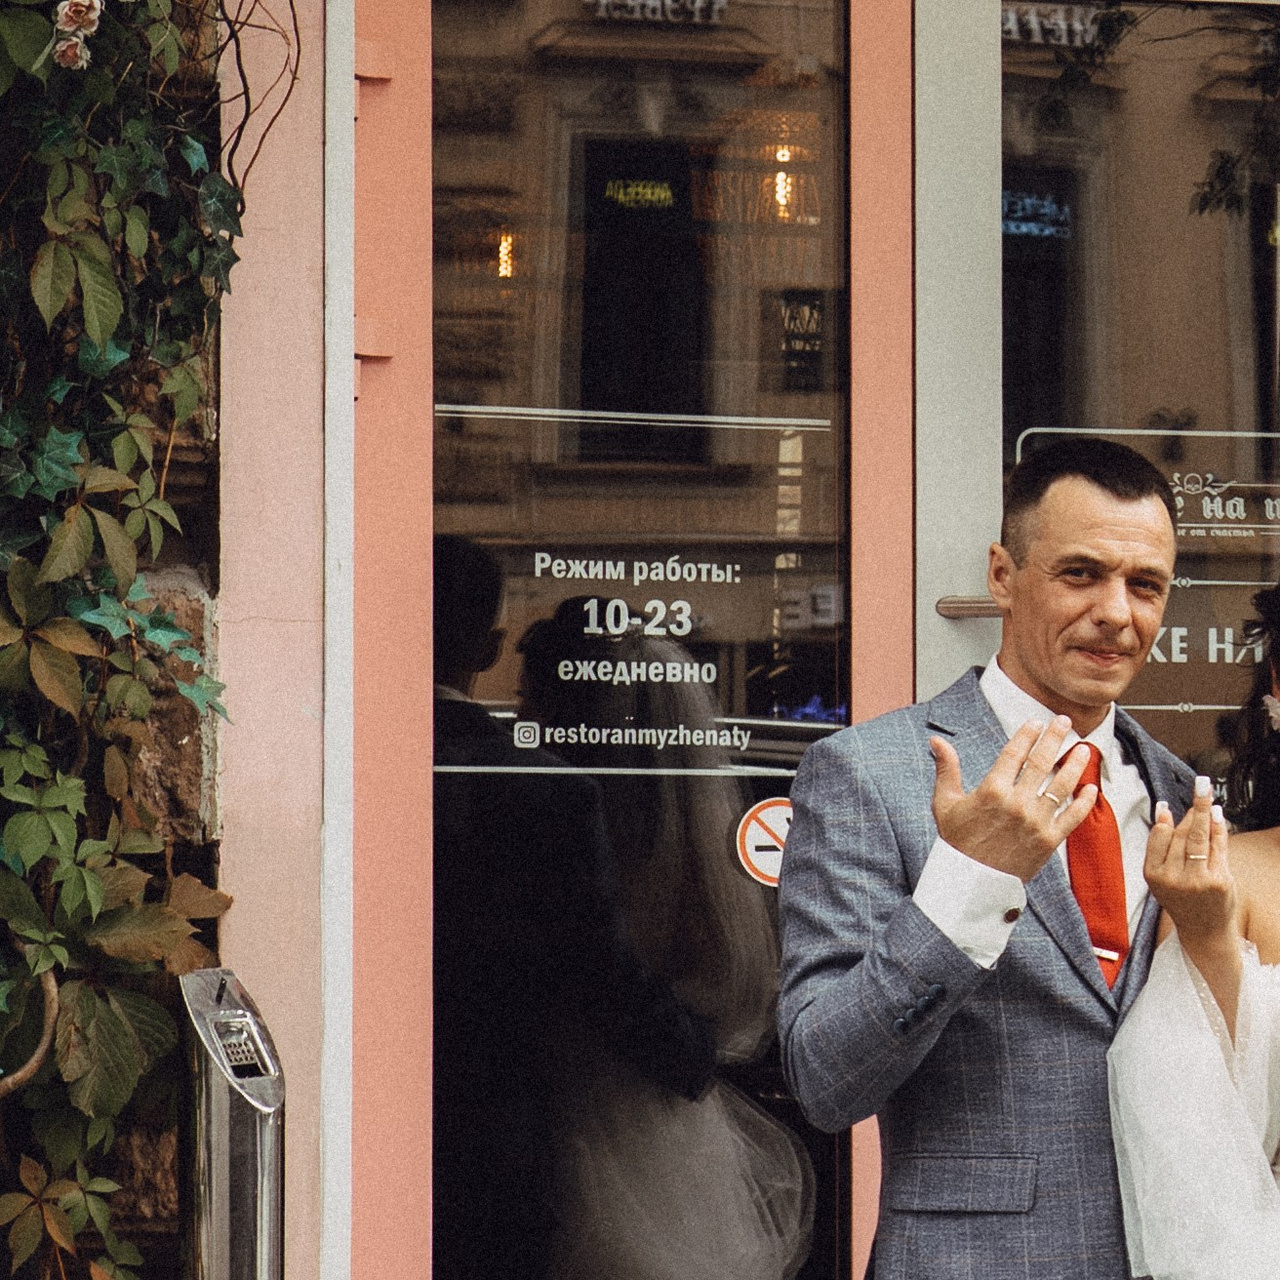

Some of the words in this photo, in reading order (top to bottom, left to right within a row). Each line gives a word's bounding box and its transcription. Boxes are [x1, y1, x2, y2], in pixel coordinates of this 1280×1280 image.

[534, 551, 626, 581] Режим
[632, 554, 742, 587] работы:
[582, 598, 693, 637] 10-23
[557, 658, 718, 686] ежедневно
[543, 722, 752, 752] restoranmyzhenaty
